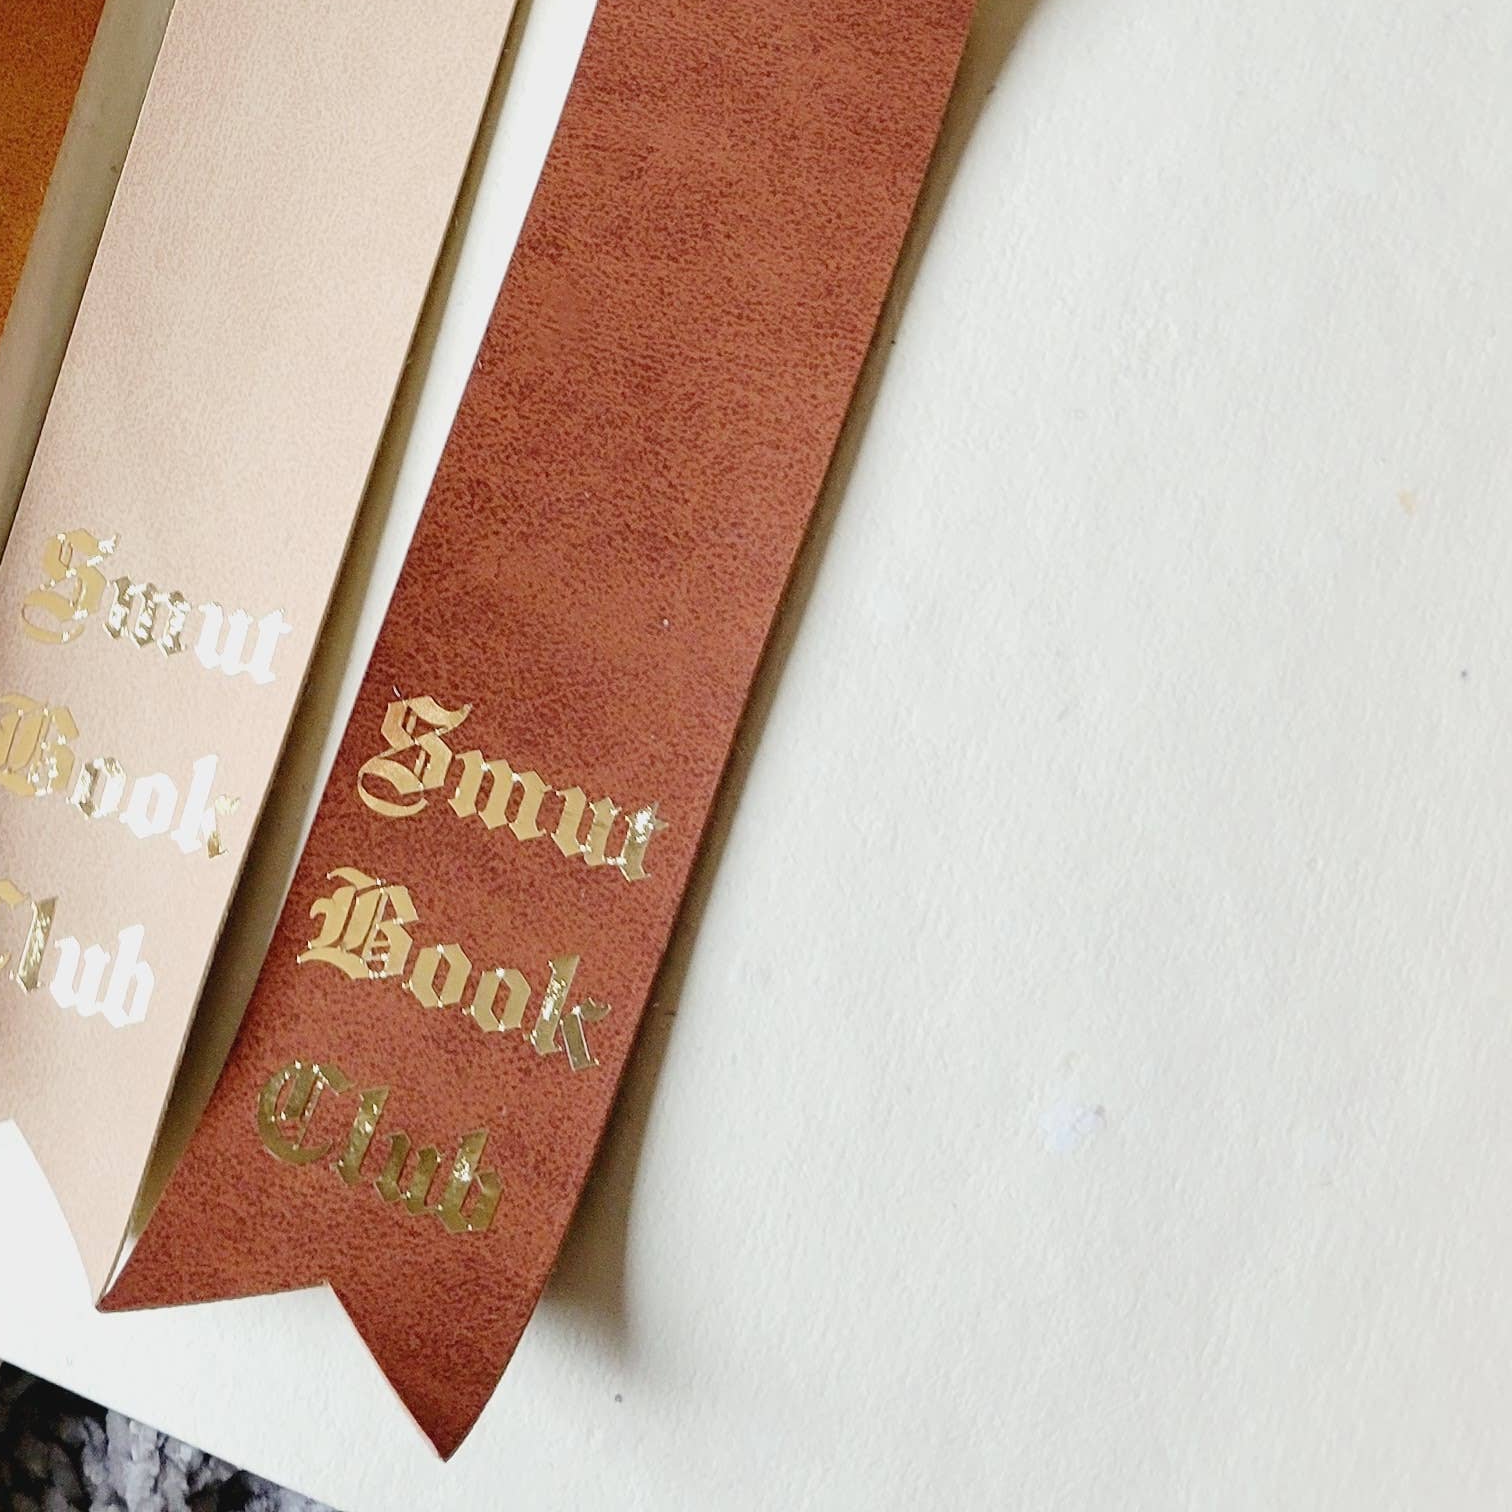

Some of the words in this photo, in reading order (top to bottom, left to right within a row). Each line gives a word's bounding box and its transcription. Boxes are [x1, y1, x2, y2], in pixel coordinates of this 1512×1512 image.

[20, 528, 292, 684] Smut
[356, 694, 670, 882] Smut
[296, 866, 612, 1072] Book
[257, 1059, 504, 1234] Club
